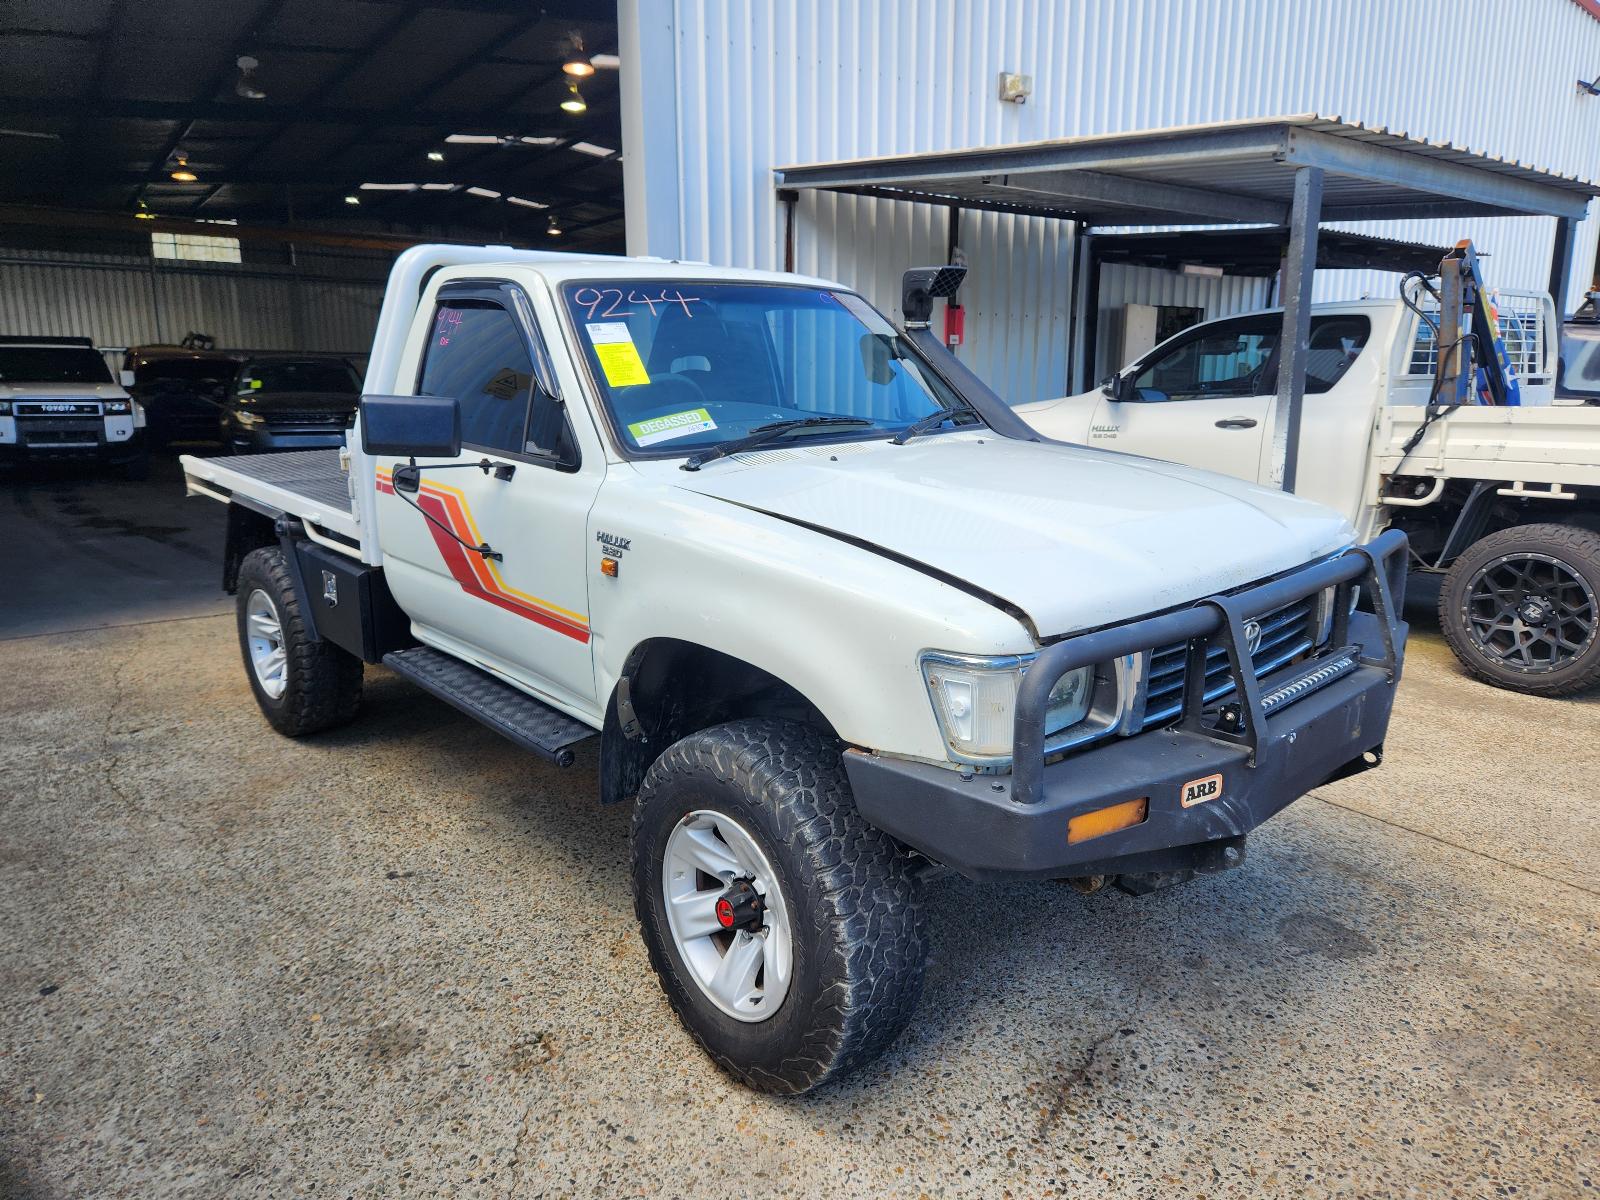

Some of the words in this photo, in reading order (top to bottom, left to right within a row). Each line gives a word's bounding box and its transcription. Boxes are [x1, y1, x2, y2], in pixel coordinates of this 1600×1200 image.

[575, 288, 700, 319] 9244
[41, 404, 77, 412] TOYOTA
[639, 412, 701, 433] DEGASSED
[1091, 424, 1120, 432] HILUX
[597, 531, 631, 551] HILUX
[1185, 781, 1217, 802] ARB
